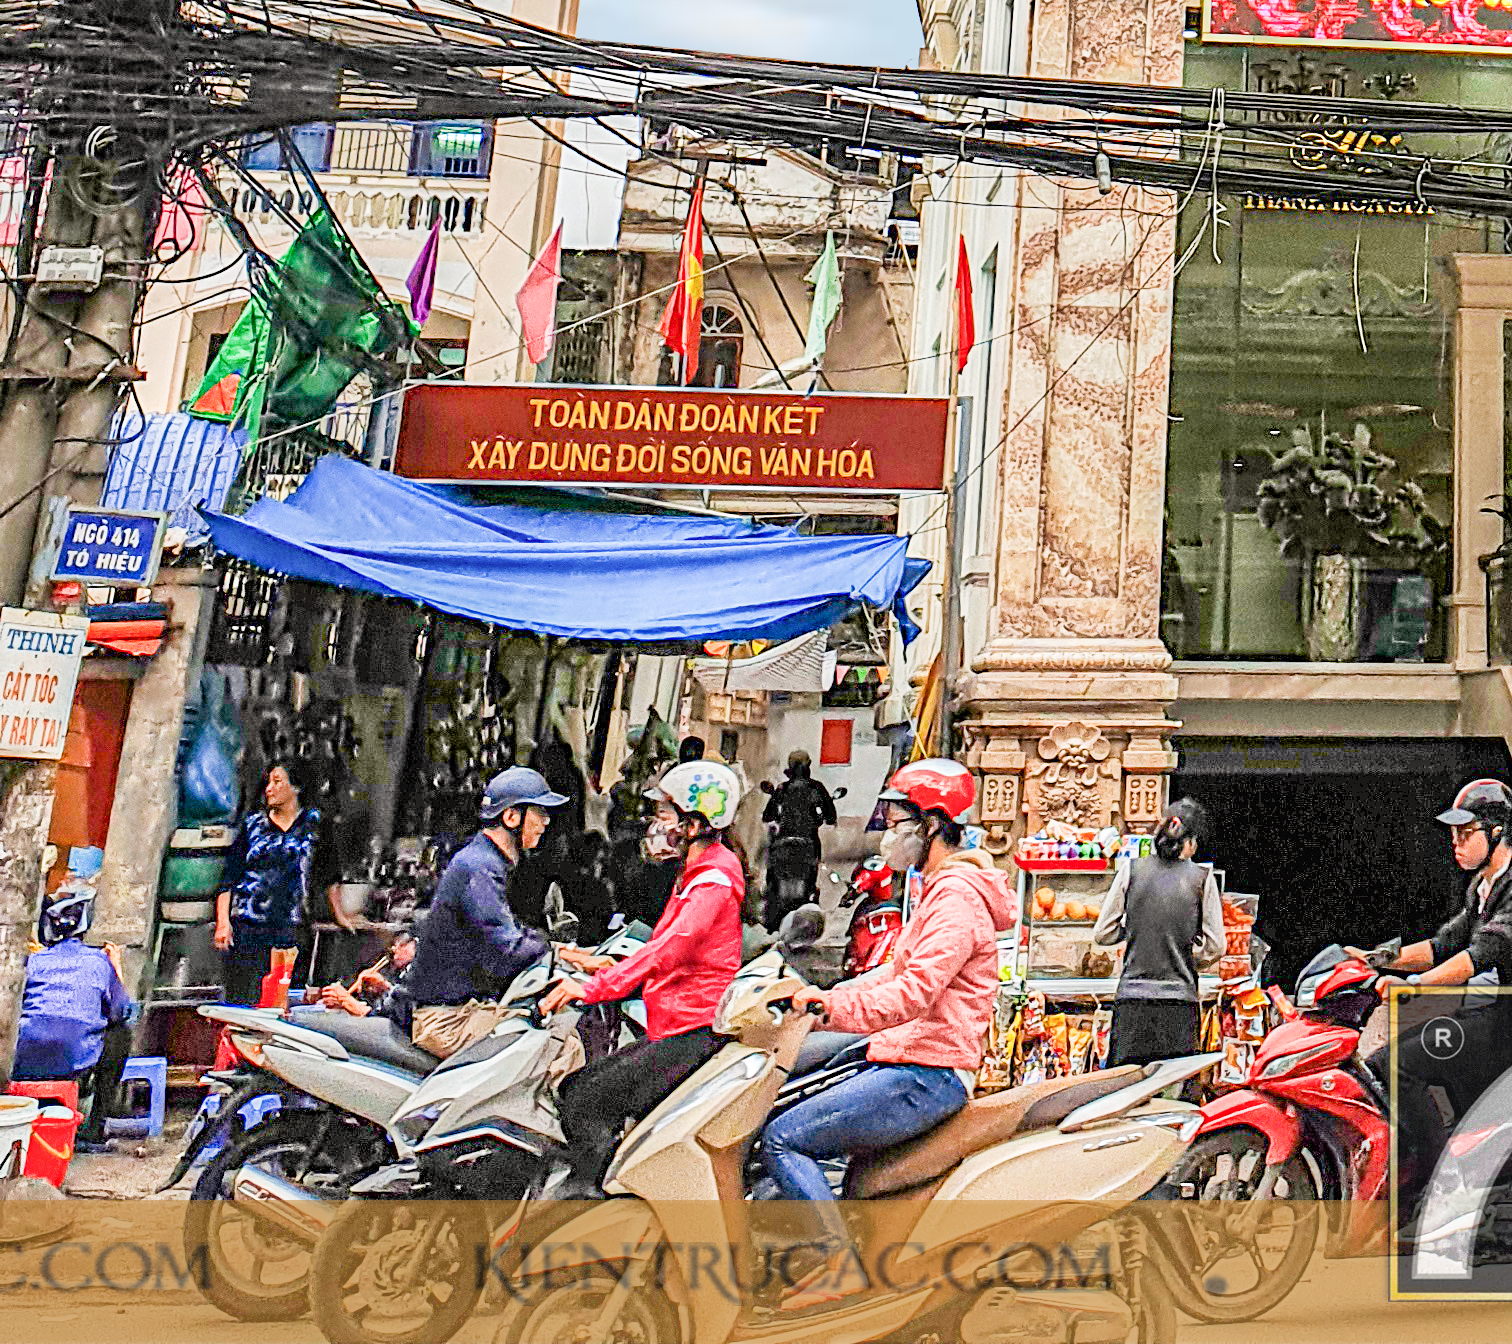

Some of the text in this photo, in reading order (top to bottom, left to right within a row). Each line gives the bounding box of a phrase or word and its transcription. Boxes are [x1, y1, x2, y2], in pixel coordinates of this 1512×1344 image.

[530, 391, 825, 435] TOÀN DÂN ĐOÀN KẾT
[467, 435, 875, 480] XÂY DỰNG ĐỜI SỐNG VĂN HÓA
[111, 526, 140, 549] 414
[95, 550, 143, 574] HIỆU
[7, 628, 78, 658] THỊNH
[32, 667, 59, 705] TÓC
[9, 710, 39, 747] RÁY
